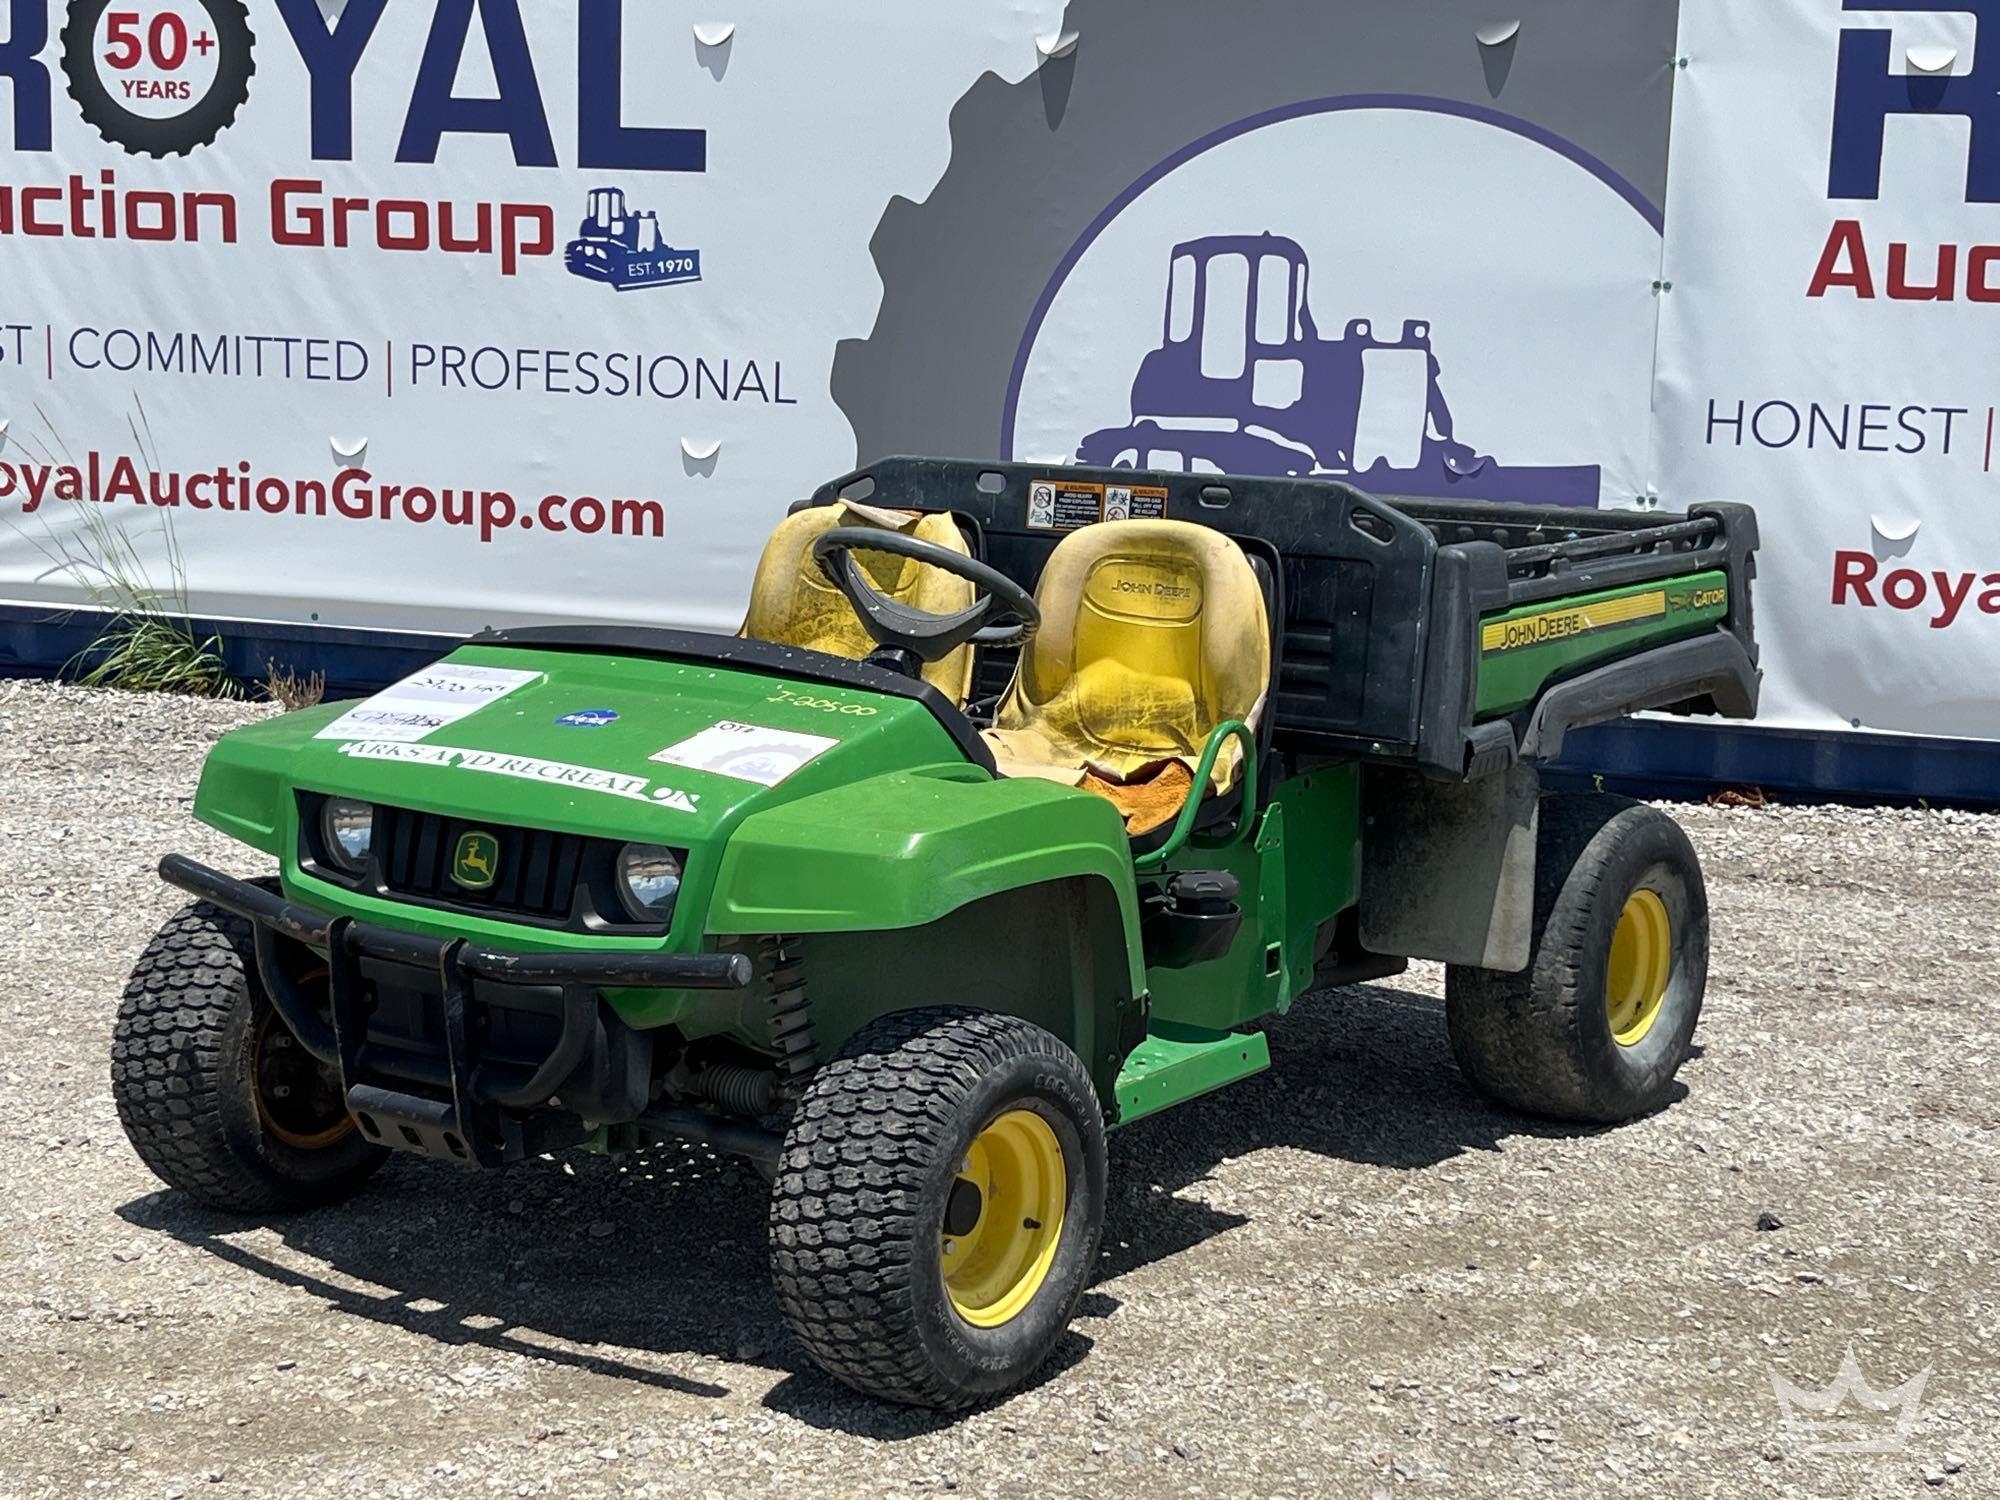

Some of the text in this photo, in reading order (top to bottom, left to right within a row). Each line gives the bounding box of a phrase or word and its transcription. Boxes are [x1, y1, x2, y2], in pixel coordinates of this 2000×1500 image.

[104, 12, 215, 71] 50+
[121, 80, 190, 99] YEARS
[0, 169, 554, 275] ction Group
[628, 259, 693, 277] EST. 1970
[69, 328, 369, 381] COMMITTED
[411, 344, 797, 404] PROFESSIONAL
[1706, 399, 1968, 454] HONEST
[1112, 580, 1191, 599] JOHN DEERE
[1693, 589, 1725, 607] GATOR
[1501, 614, 1579, 647] JOHN DEERE
[348, 742, 425, 758] ARKS
[426, 749, 496, 767] AND
[499, 757, 700, 812] RECREATON
